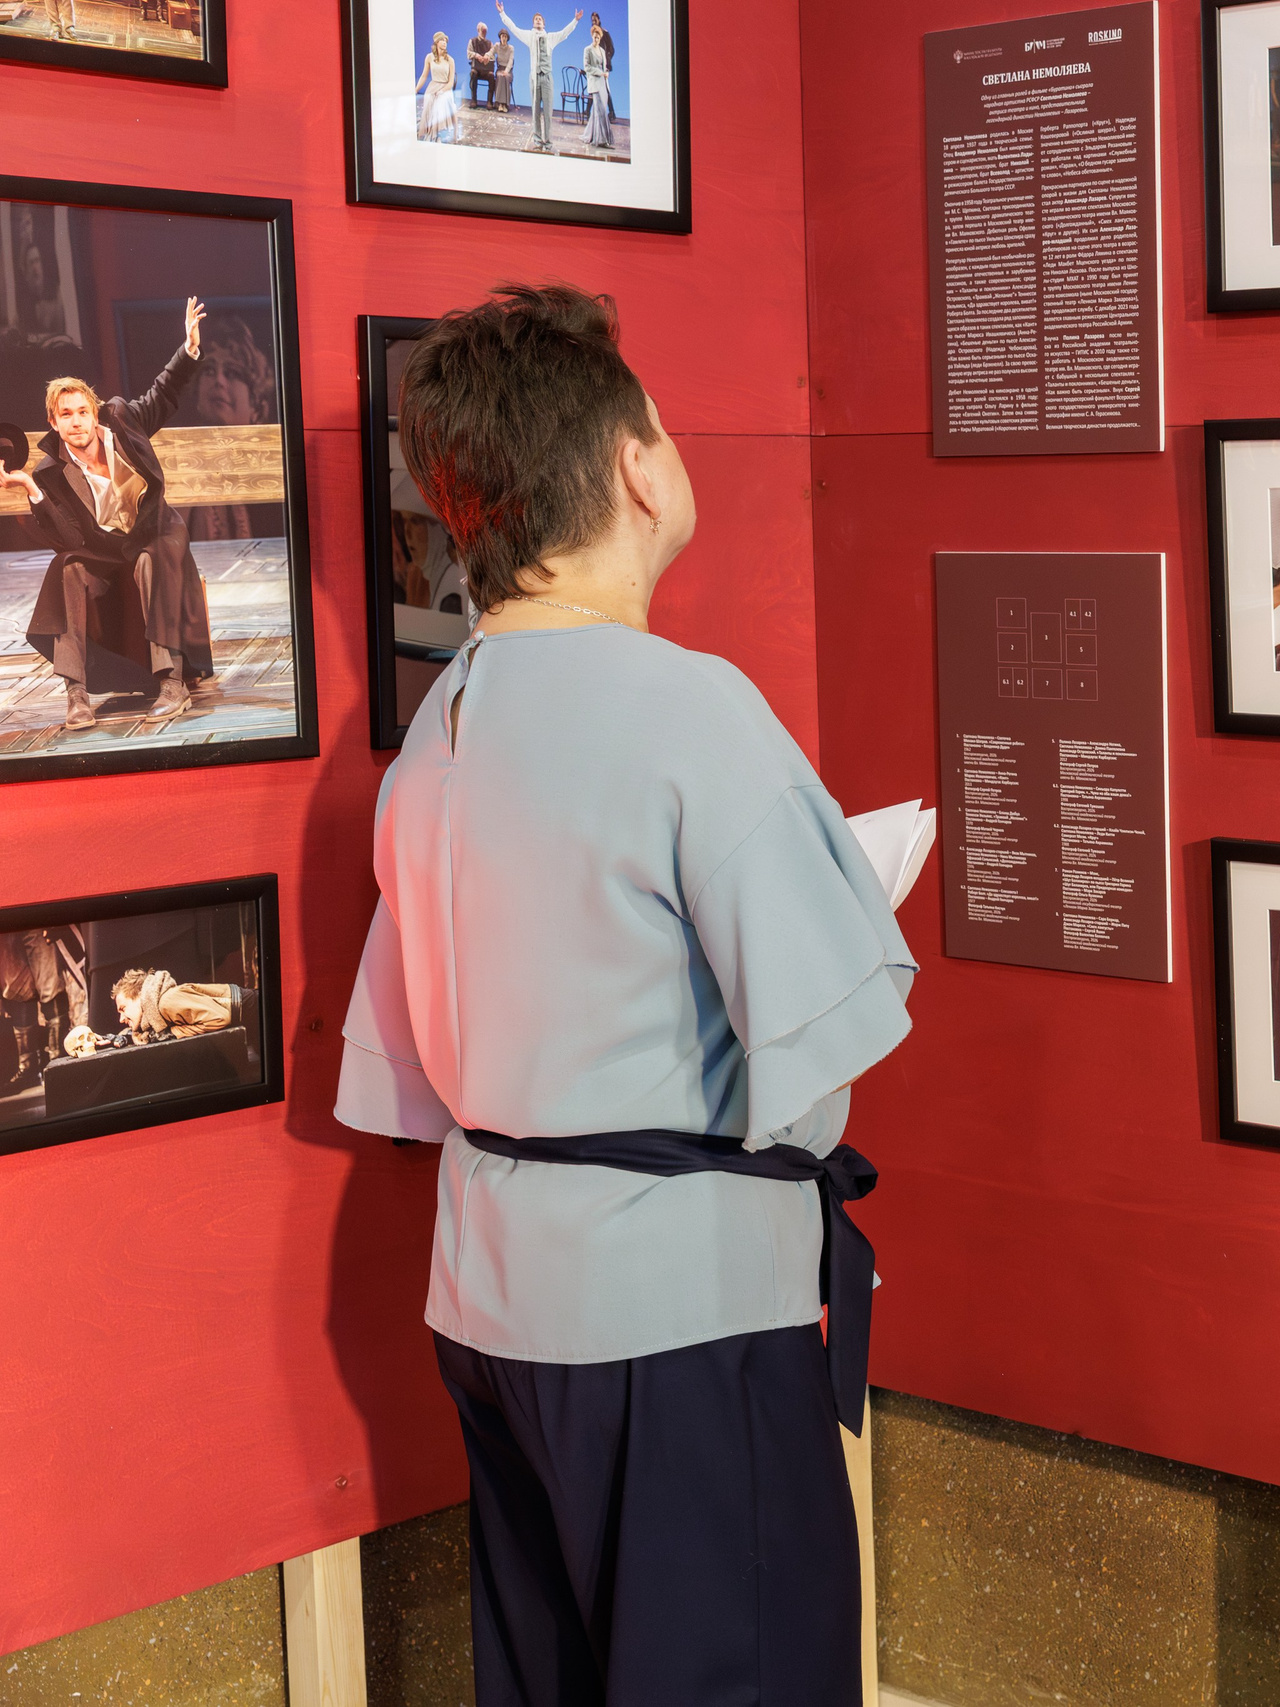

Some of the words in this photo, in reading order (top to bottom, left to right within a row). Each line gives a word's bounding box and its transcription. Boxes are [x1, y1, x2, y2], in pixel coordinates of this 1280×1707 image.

[1088, 28, 1122, 43] ROSKINO
[982, 70, 1030, 86] СВЕТЛАНА
[1032, 62, 1091, 79] НЕМОЛЯЕВА
